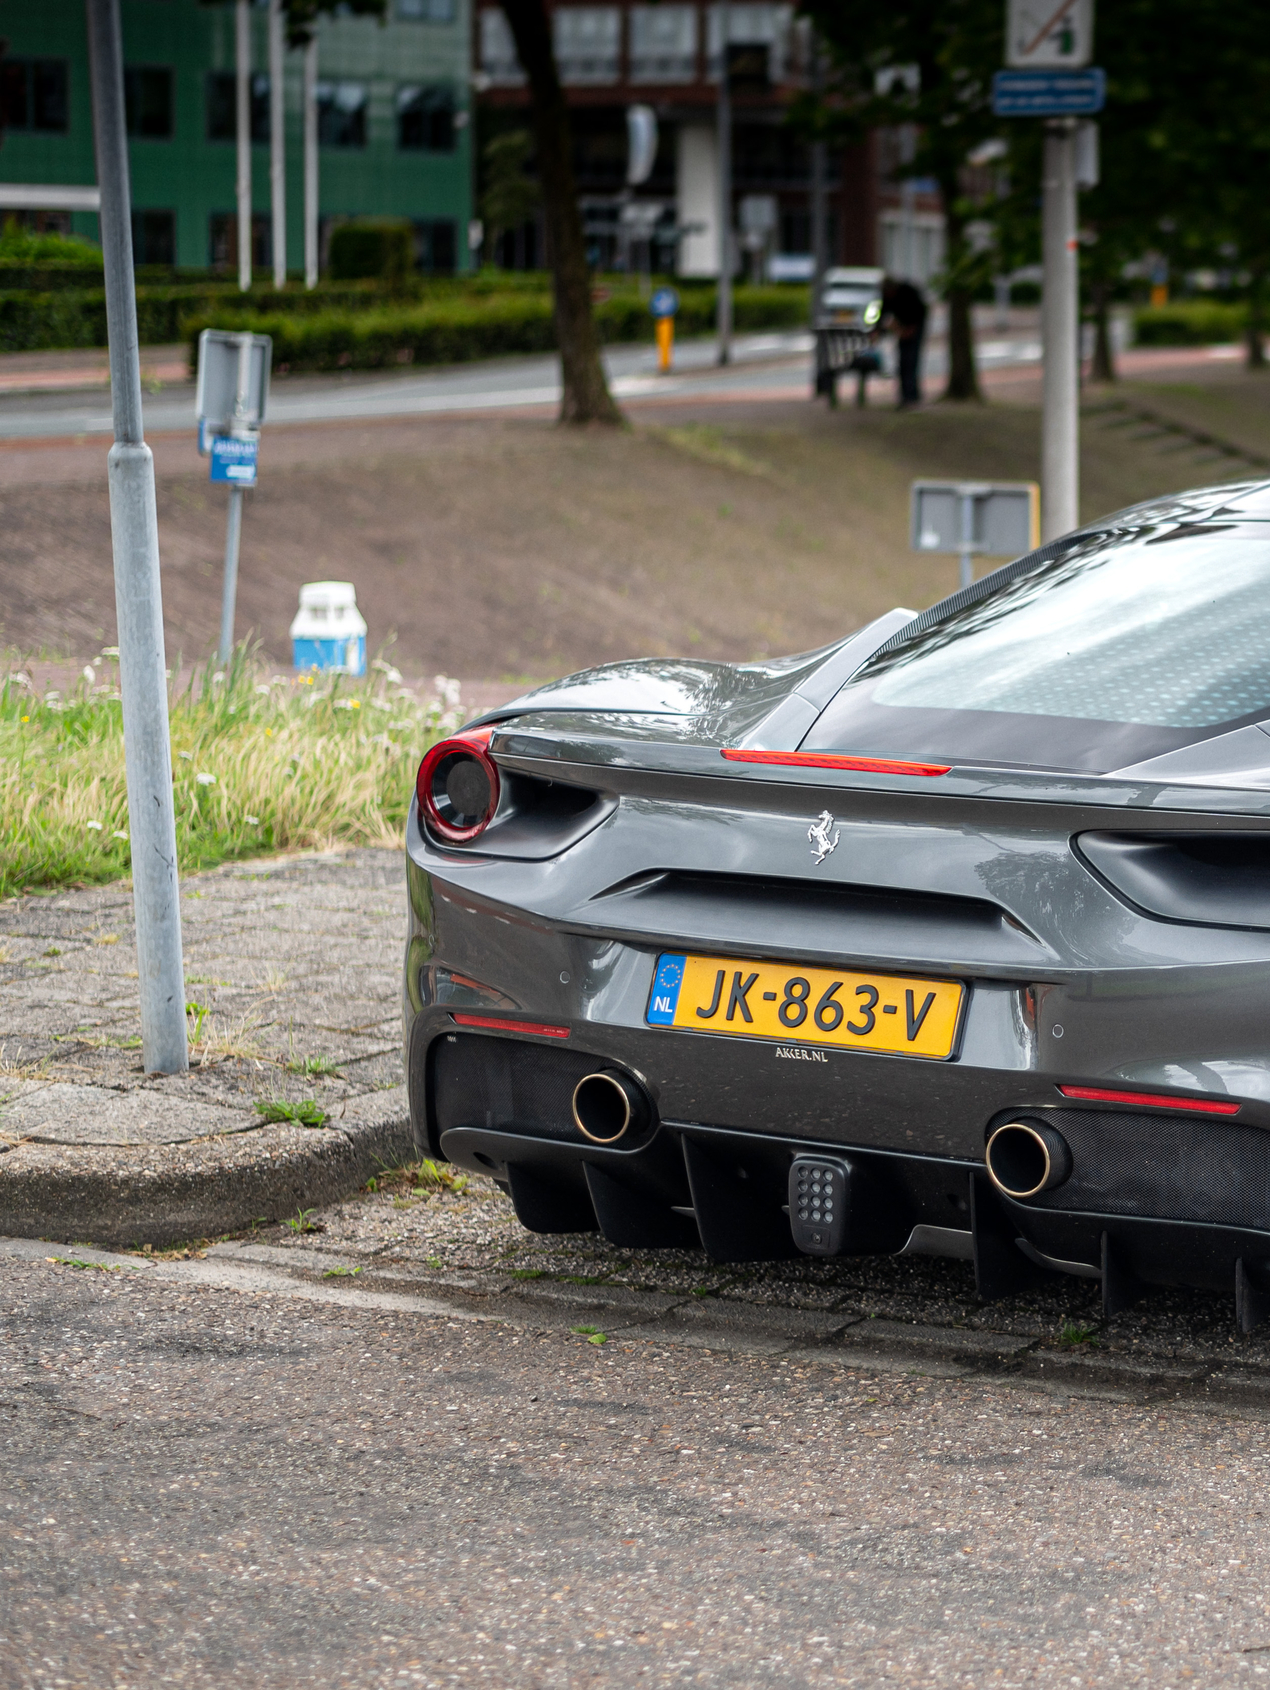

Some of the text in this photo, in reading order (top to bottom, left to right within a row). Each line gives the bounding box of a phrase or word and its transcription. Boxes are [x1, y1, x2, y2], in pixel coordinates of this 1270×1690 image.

[653, 995, 674, 1014] NL
[696, 969, 937, 1042] JK-863-V
[775, 1046, 829, 1063] AKKER.NL
